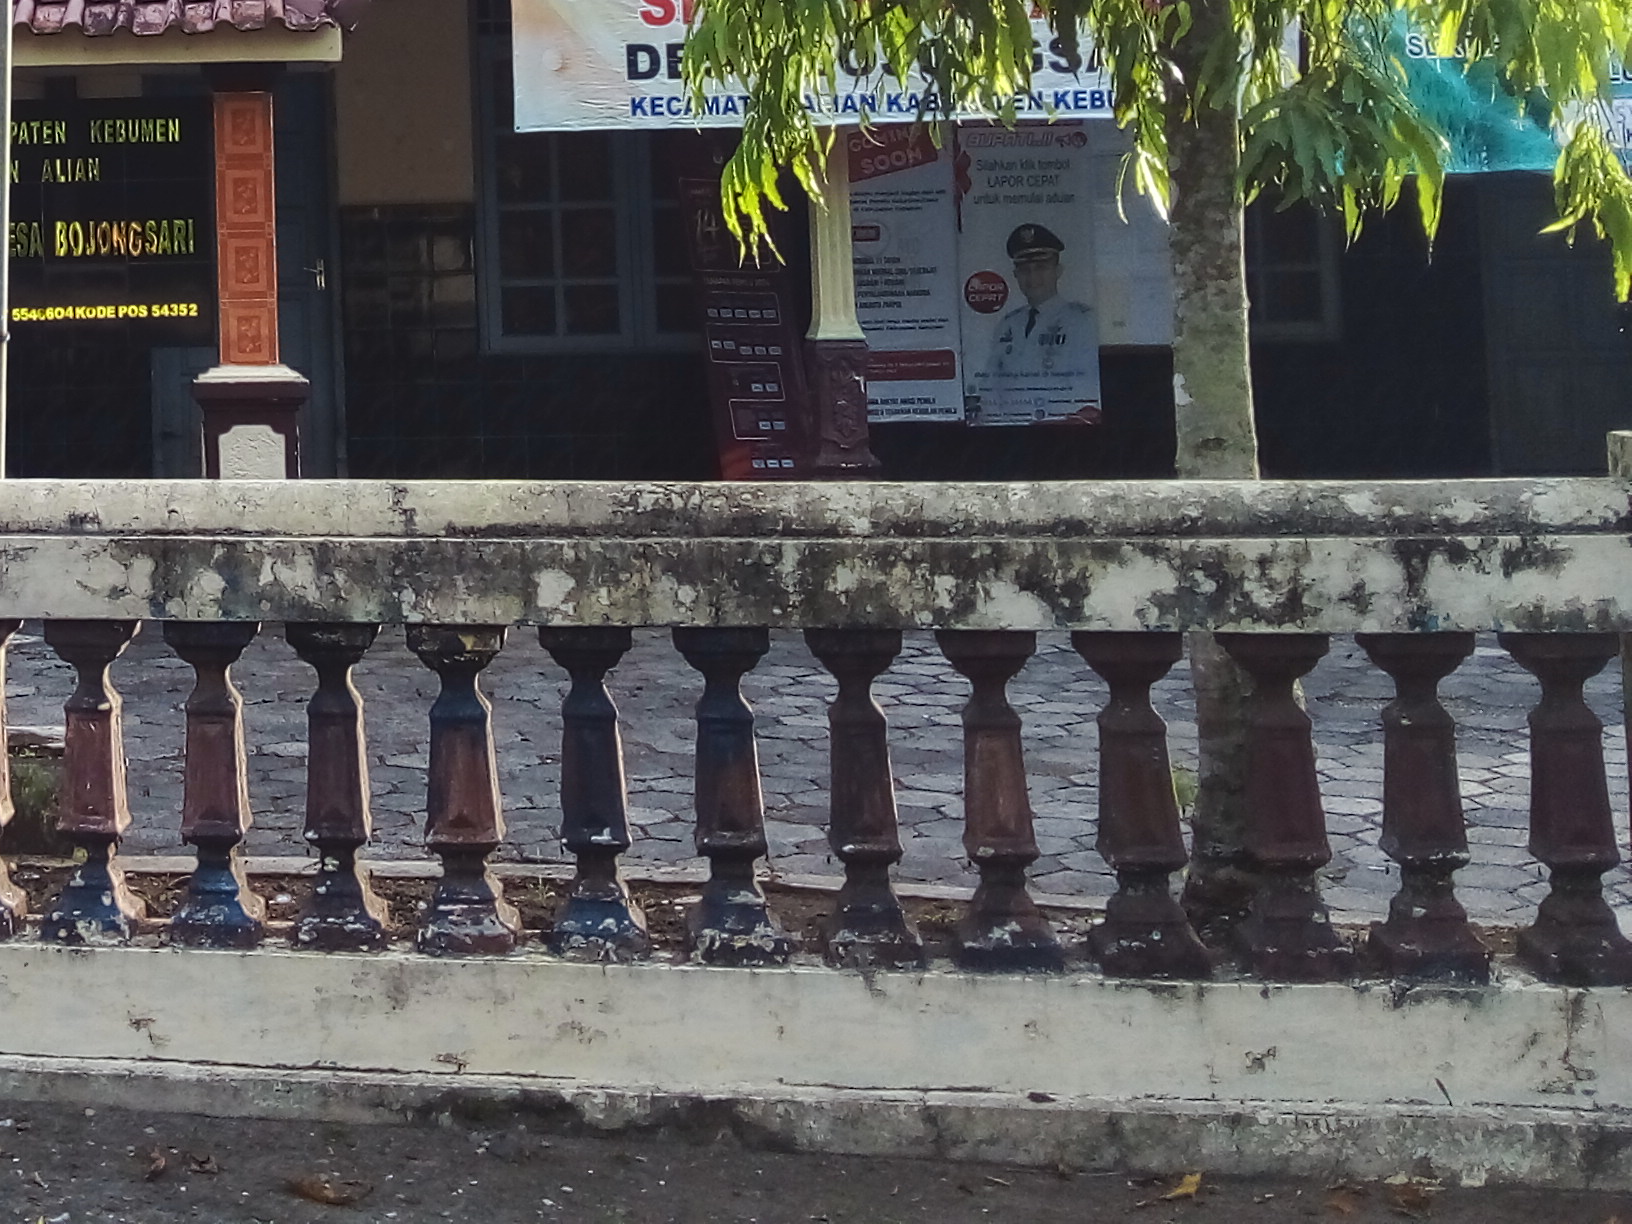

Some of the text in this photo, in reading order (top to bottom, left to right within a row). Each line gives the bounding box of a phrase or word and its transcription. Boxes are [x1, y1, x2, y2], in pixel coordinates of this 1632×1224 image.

[631, 95, 752, 116] KECAMAT
[90, 118, 181, 144] KEBUMEN
[41, 157, 101, 183] ALIAN
[860, 147, 923, 175] SOON
[1037, 158, 1070, 171] tombol
[987, 174, 1060, 188] LAPOR CEPAT
[9, 222, 45, 257] ESA
[54, 219, 195, 257] BOJONGSARI
[75, 305, 116, 320] KODE
[118, 304, 148, 318] POS
[151, 303, 199, 317] 54352
